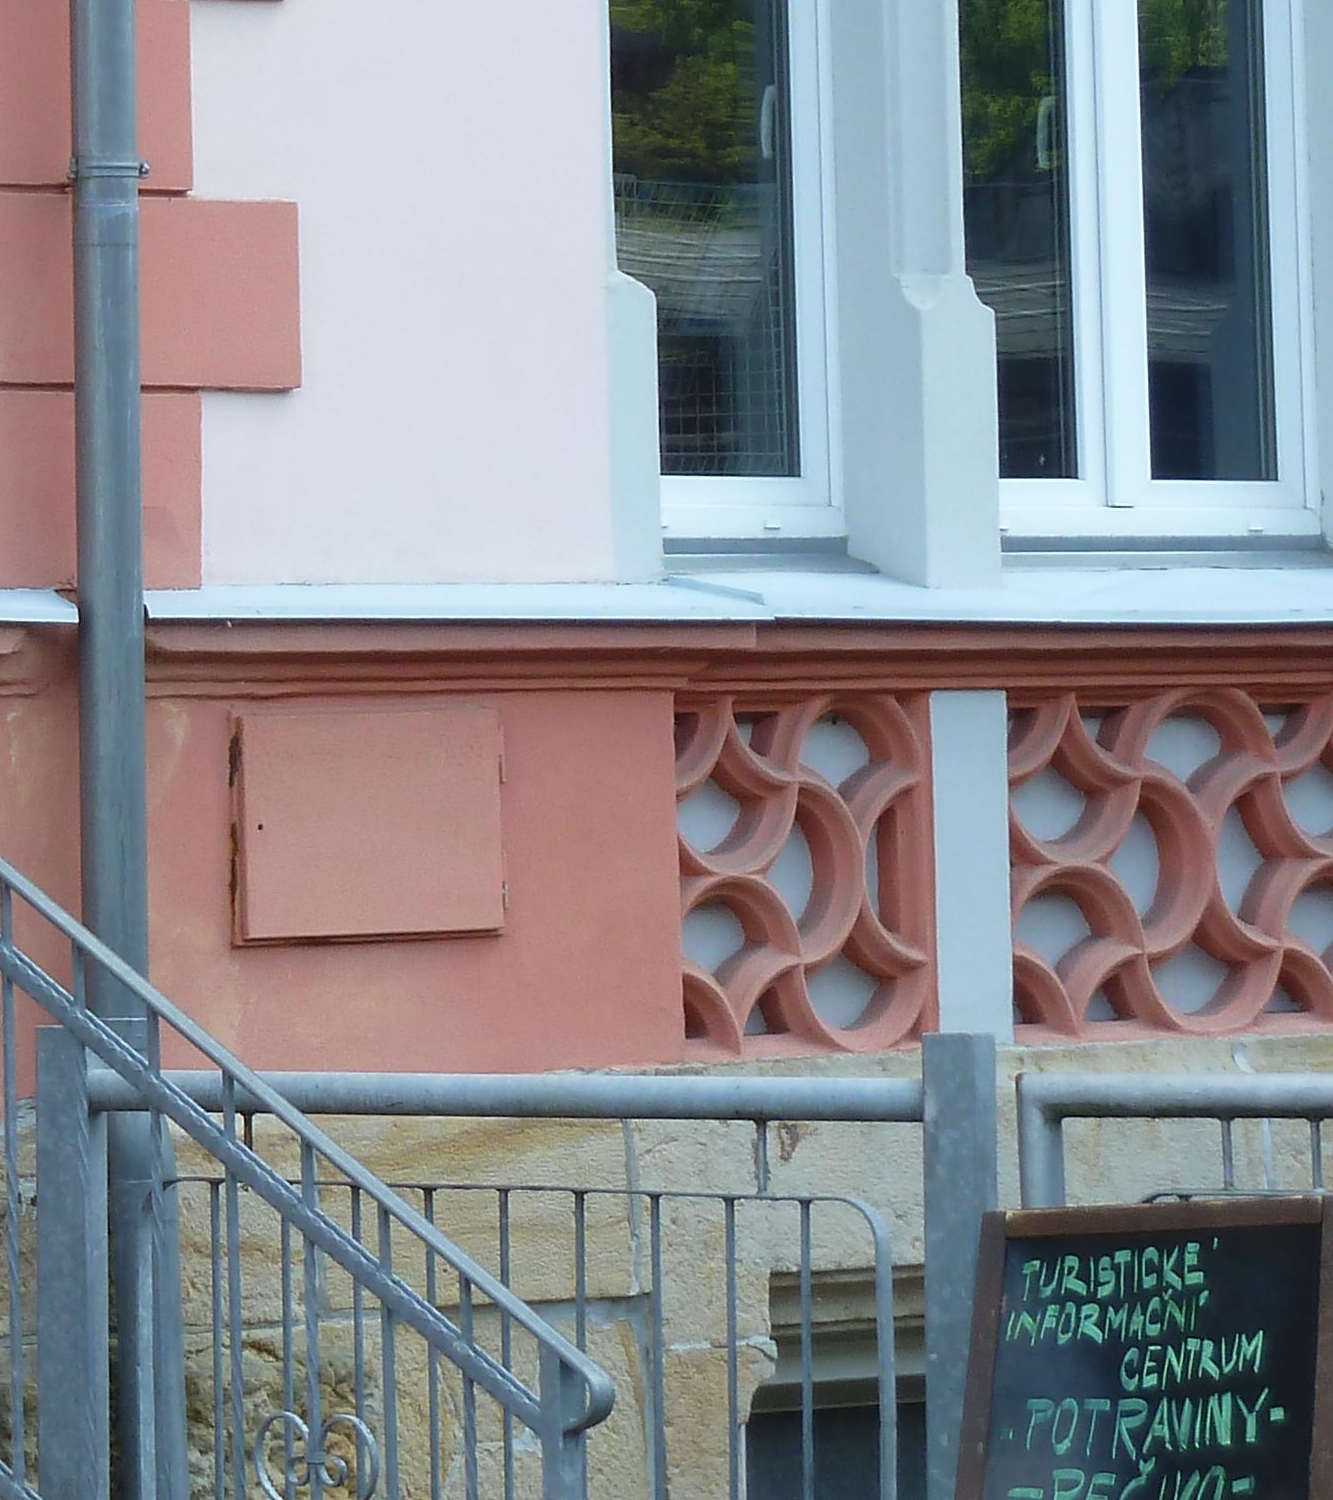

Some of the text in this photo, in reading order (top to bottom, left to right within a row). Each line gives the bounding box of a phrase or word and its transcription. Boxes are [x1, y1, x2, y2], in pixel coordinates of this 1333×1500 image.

[1021, 1237, 1220, 1301] TURISTICKÉ
[1005, 1289, 1211, 1347] INFORMAČNÍ
[1119, 1329, 1264, 1392] CENTRUM
